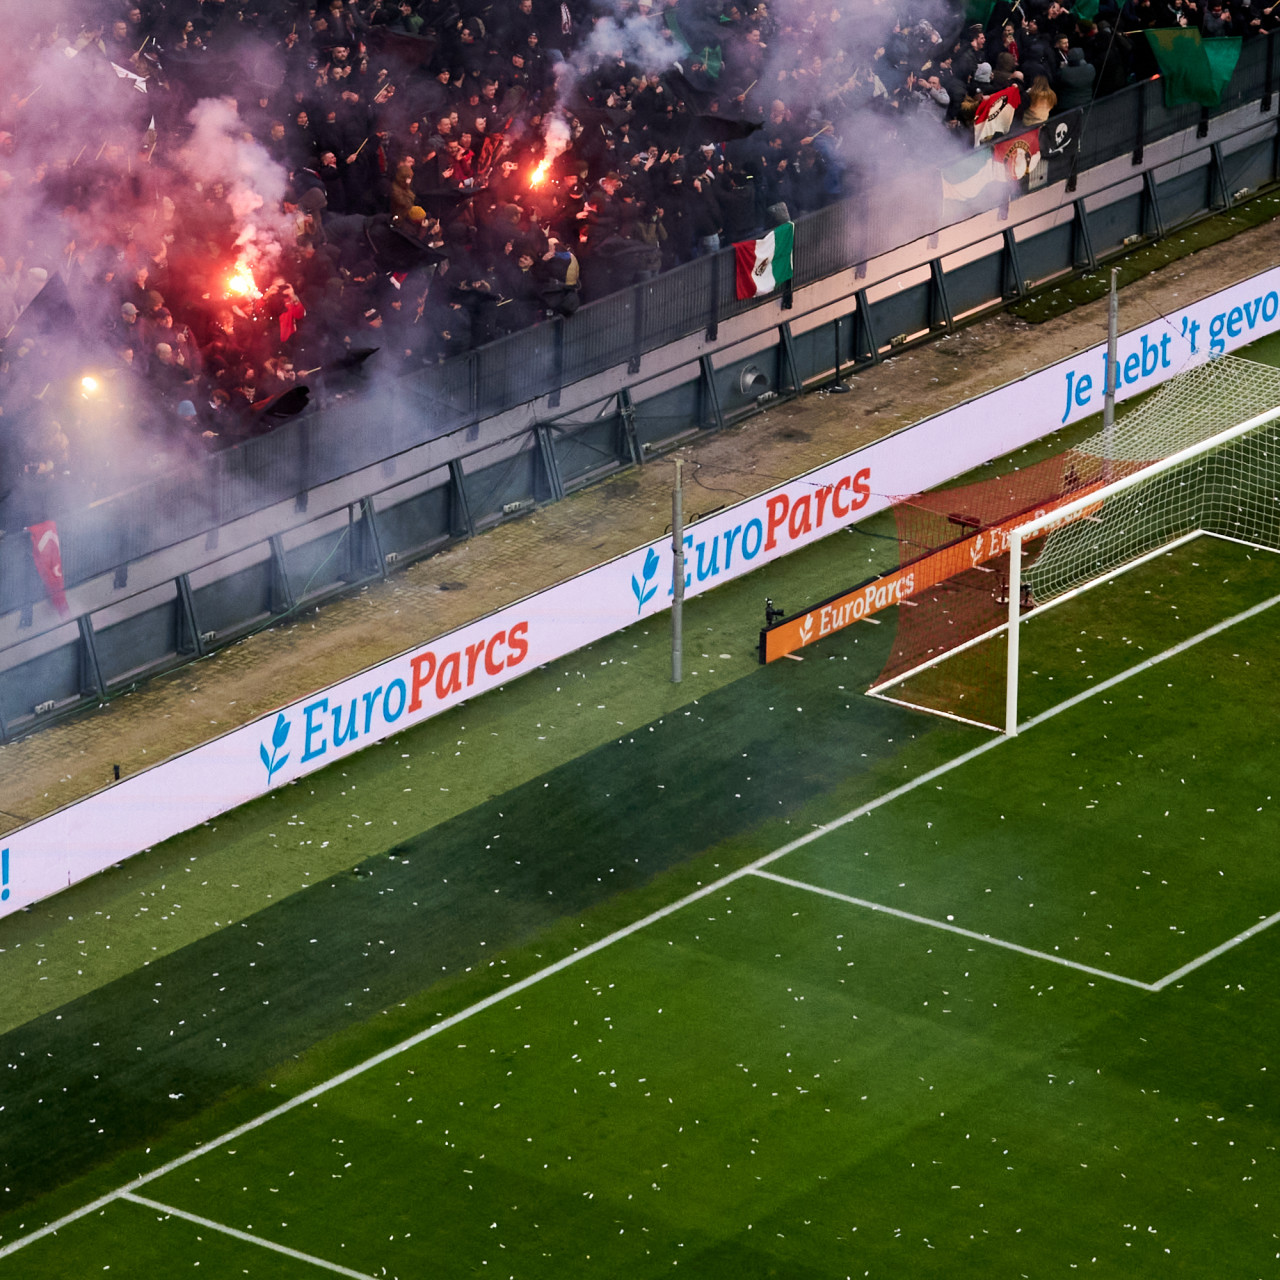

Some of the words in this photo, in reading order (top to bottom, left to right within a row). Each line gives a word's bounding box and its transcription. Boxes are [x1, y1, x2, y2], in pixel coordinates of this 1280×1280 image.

[1062, 369, 1093, 424] Je
[667, 467, 871, 597] EuroParcs
[818, 572, 916, 636] EuroParcs
[300, 621, 529, 764] EuroParcs
